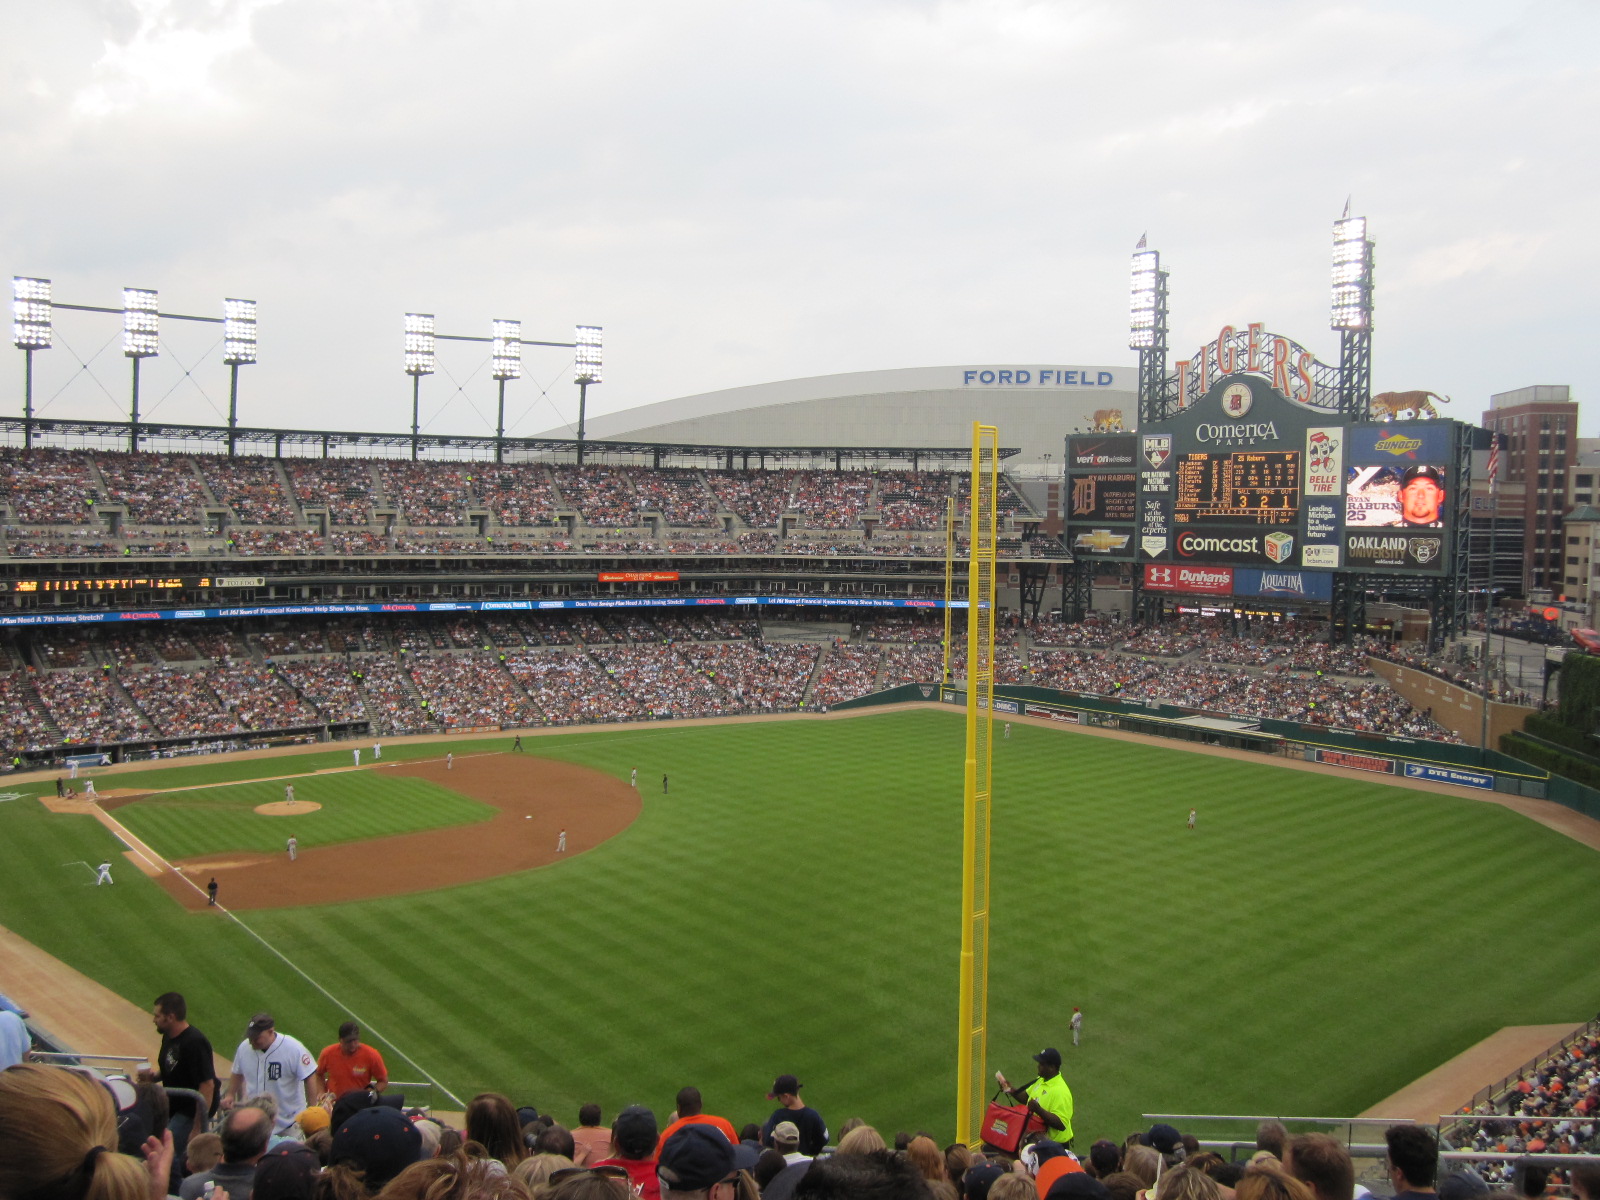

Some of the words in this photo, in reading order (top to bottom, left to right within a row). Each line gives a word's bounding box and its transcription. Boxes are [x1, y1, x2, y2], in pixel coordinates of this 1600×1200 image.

[1175, 322, 1314, 408] TIGERS
[964, 370, 1031, 384] FORD
[1039, 370, 1113, 386] FIELD
[1145, 439, 1169, 448] MLB
[1376, 440, 1420, 450] SUNOCO
[1076, 454, 1109, 465] verizon
[1310, 476, 1337, 484] BELLE
[1145, 501, 1161, 510] Safe
[1240, 496, 1247, 508] 3
[1260, 496, 1268, 508] 2
[1282, 496, 1289, 508] 1
[1308, 505, 1332, 514] Leading
[1347, 510, 1366, 520] 25
[1144, 513, 1166, 522] home
[1308, 512, 1336, 520] Michigan
[1142, 527, 1167, 535] experts
[1348, 536, 1407, 551] OAKLAND
[1349, 548, 1406, 559] UNIVERSITY
[1180, 570, 1230, 583] Dunham's
[1259, 571, 1304, 592] AQUAFINA
[1428, 769, 1448, 778] DTE
[1450, 772, 1487, 785] Energy
[268, 1062, 282, 1080] D
